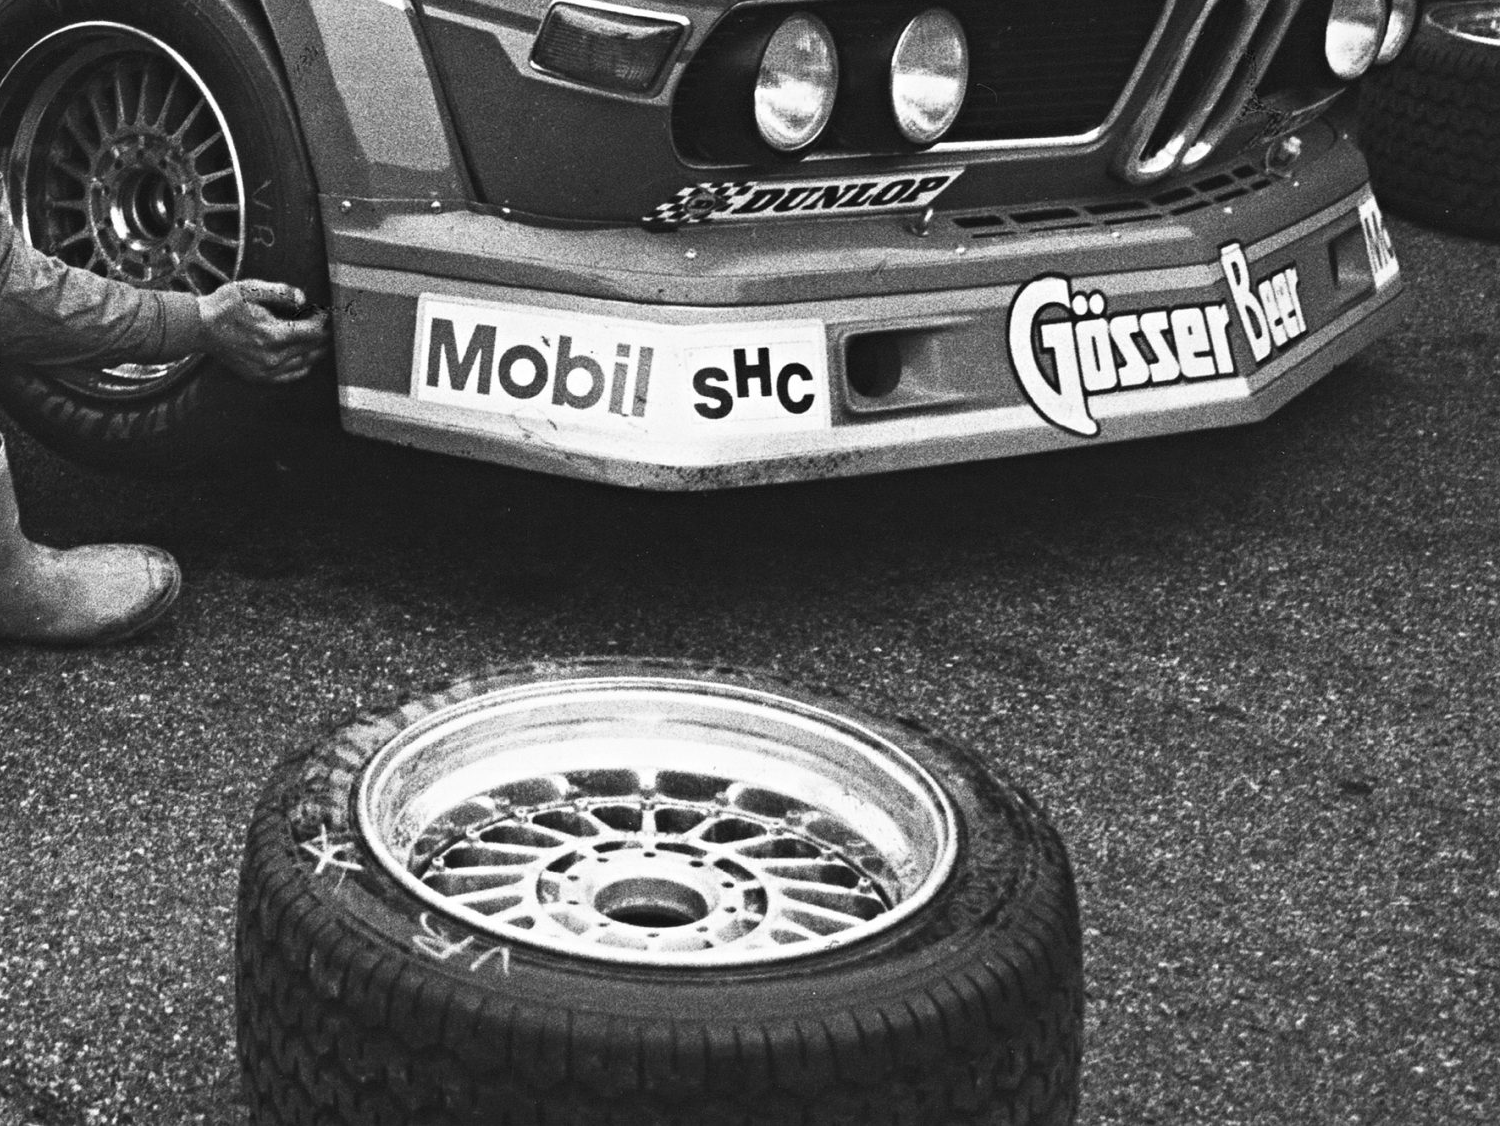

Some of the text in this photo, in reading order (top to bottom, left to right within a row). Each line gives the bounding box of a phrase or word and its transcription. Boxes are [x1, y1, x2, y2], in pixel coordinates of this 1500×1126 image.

[729, 175, 952, 215] DUNLOP
[425, 317, 655, 418] Mobil
[1007, 274, 1235, 437] Gösser
[1220, 241, 1308, 363] Beer
